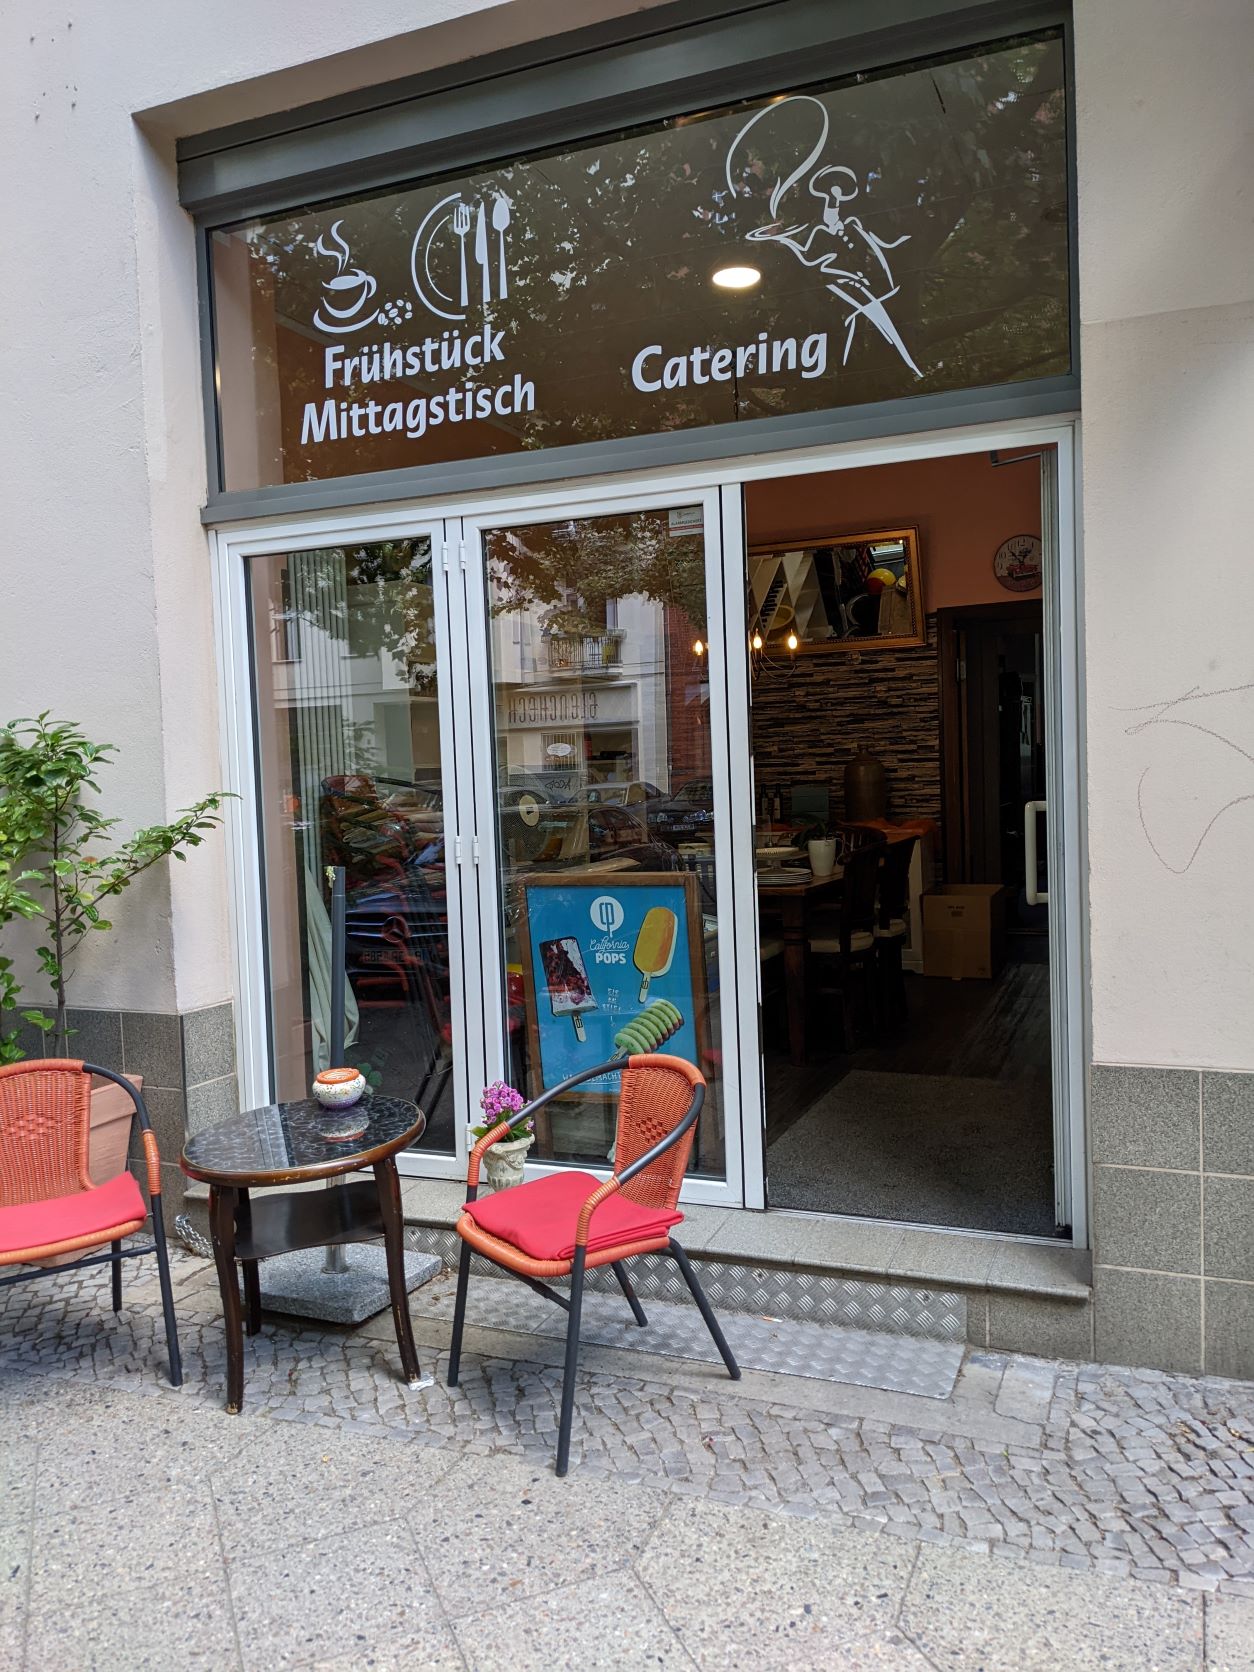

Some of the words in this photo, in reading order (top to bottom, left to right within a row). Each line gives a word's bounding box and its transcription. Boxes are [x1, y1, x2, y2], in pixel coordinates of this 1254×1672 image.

[324, 323, 506, 389] Frühstück
[631, 332, 828, 393] Catering
[301, 373, 535, 445] Mittagstisch
[590, 936, 630, 954] California
[595, 952, 627, 964] POPS
